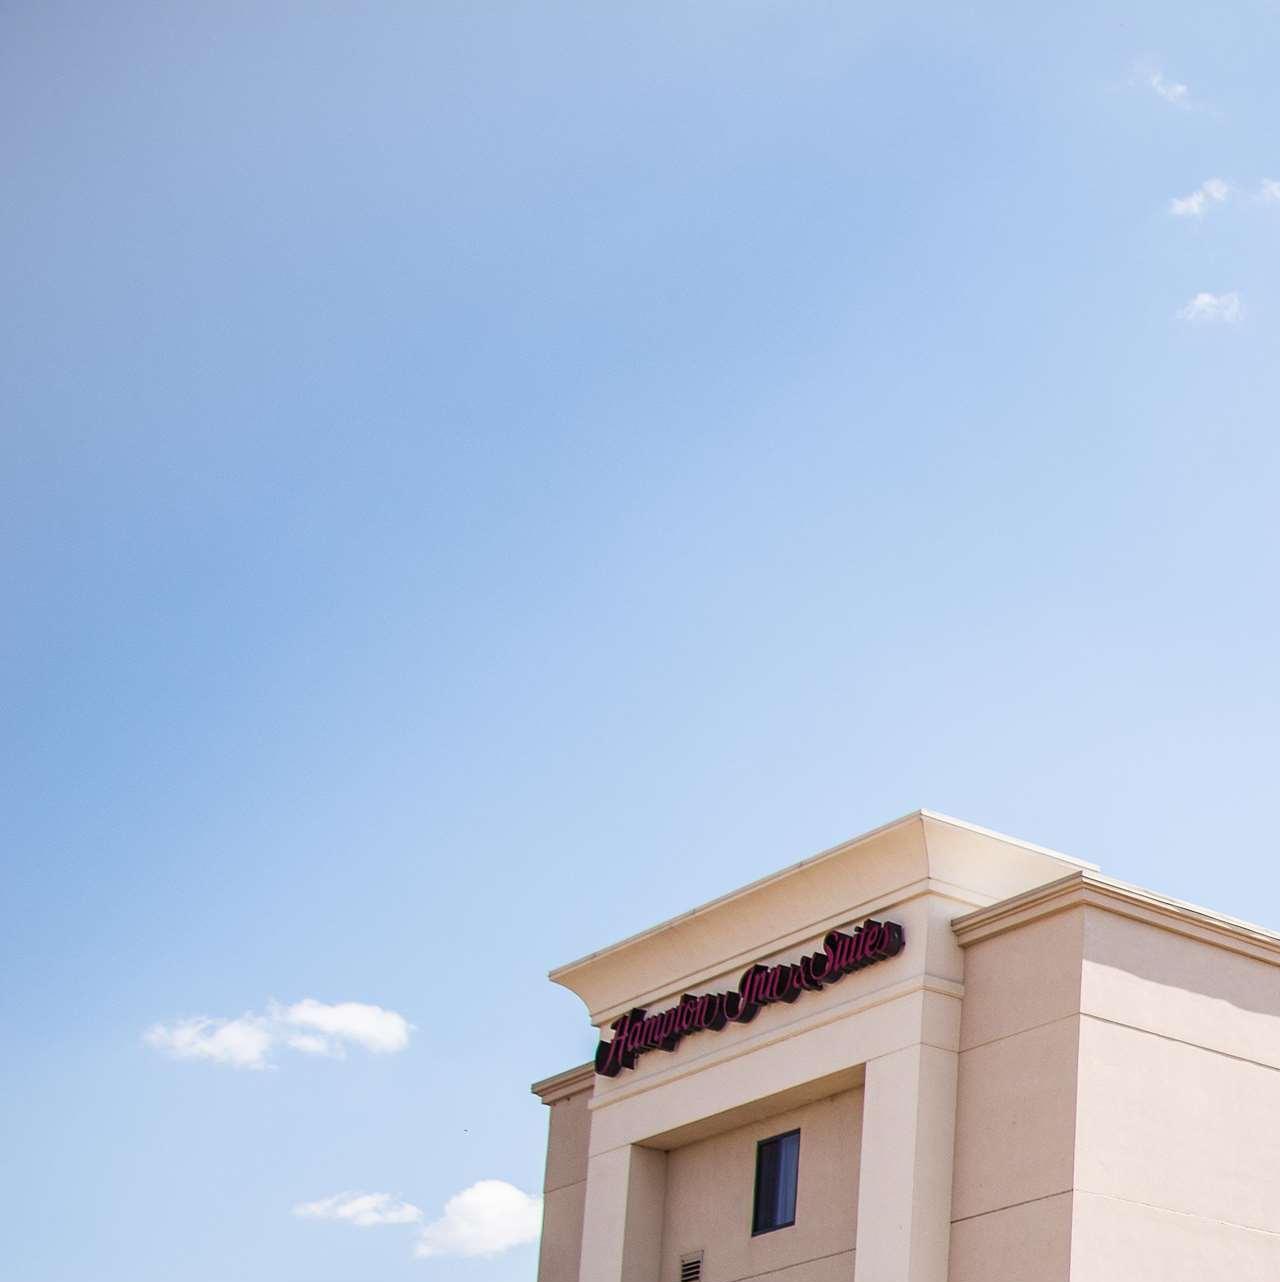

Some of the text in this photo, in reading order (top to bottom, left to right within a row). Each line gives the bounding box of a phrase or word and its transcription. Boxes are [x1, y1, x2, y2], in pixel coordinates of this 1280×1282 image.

[594, 994, 729, 1077] Hampton
[724, 964, 802, 1023] Inn
[811, 919, 905, 984] Suites
